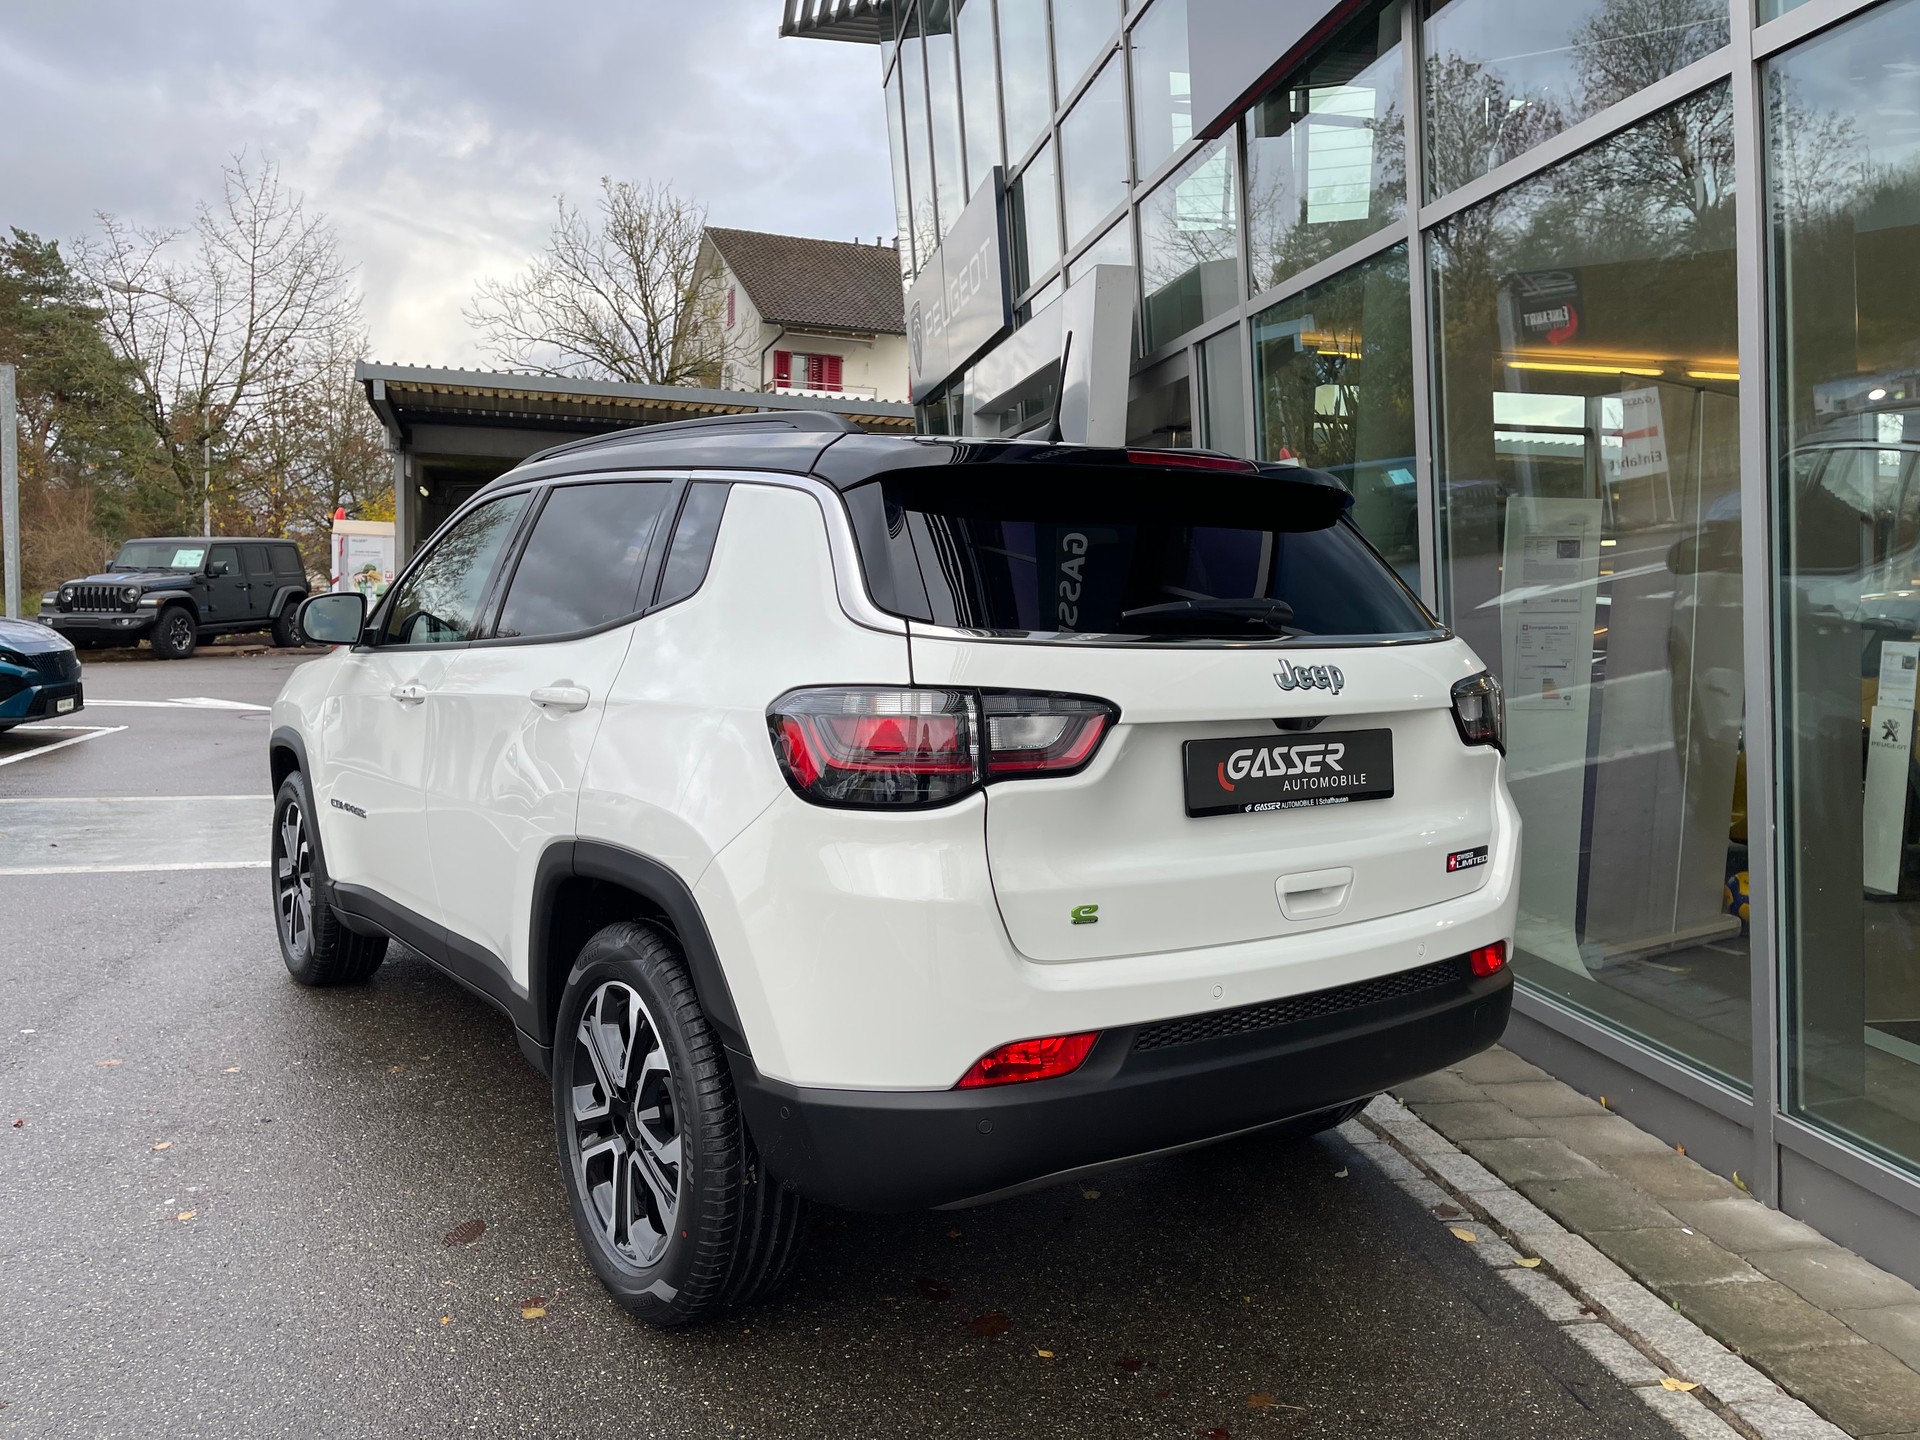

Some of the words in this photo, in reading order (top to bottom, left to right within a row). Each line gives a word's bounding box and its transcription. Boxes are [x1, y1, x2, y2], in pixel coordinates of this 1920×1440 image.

[924, 236, 991, 346] PEUGEOT
[1273, 658, 1345, 695] Jeep
[1871, 741, 1907, 750] PEUGEOT
[1227, 742, 1346, 780] GASSER
[1282, 773, 1367, 792] AUTOMOBILE
[1254, 802, 1281, 811] GASSER
[1281, 798, 1315, 809] AUTOMOBILE
[1319, 796, 1349, 805] Schaffhausen
[1456, 851, 1474, 861] SWISS
[1456, 854, 1488, 868] LIMITED
